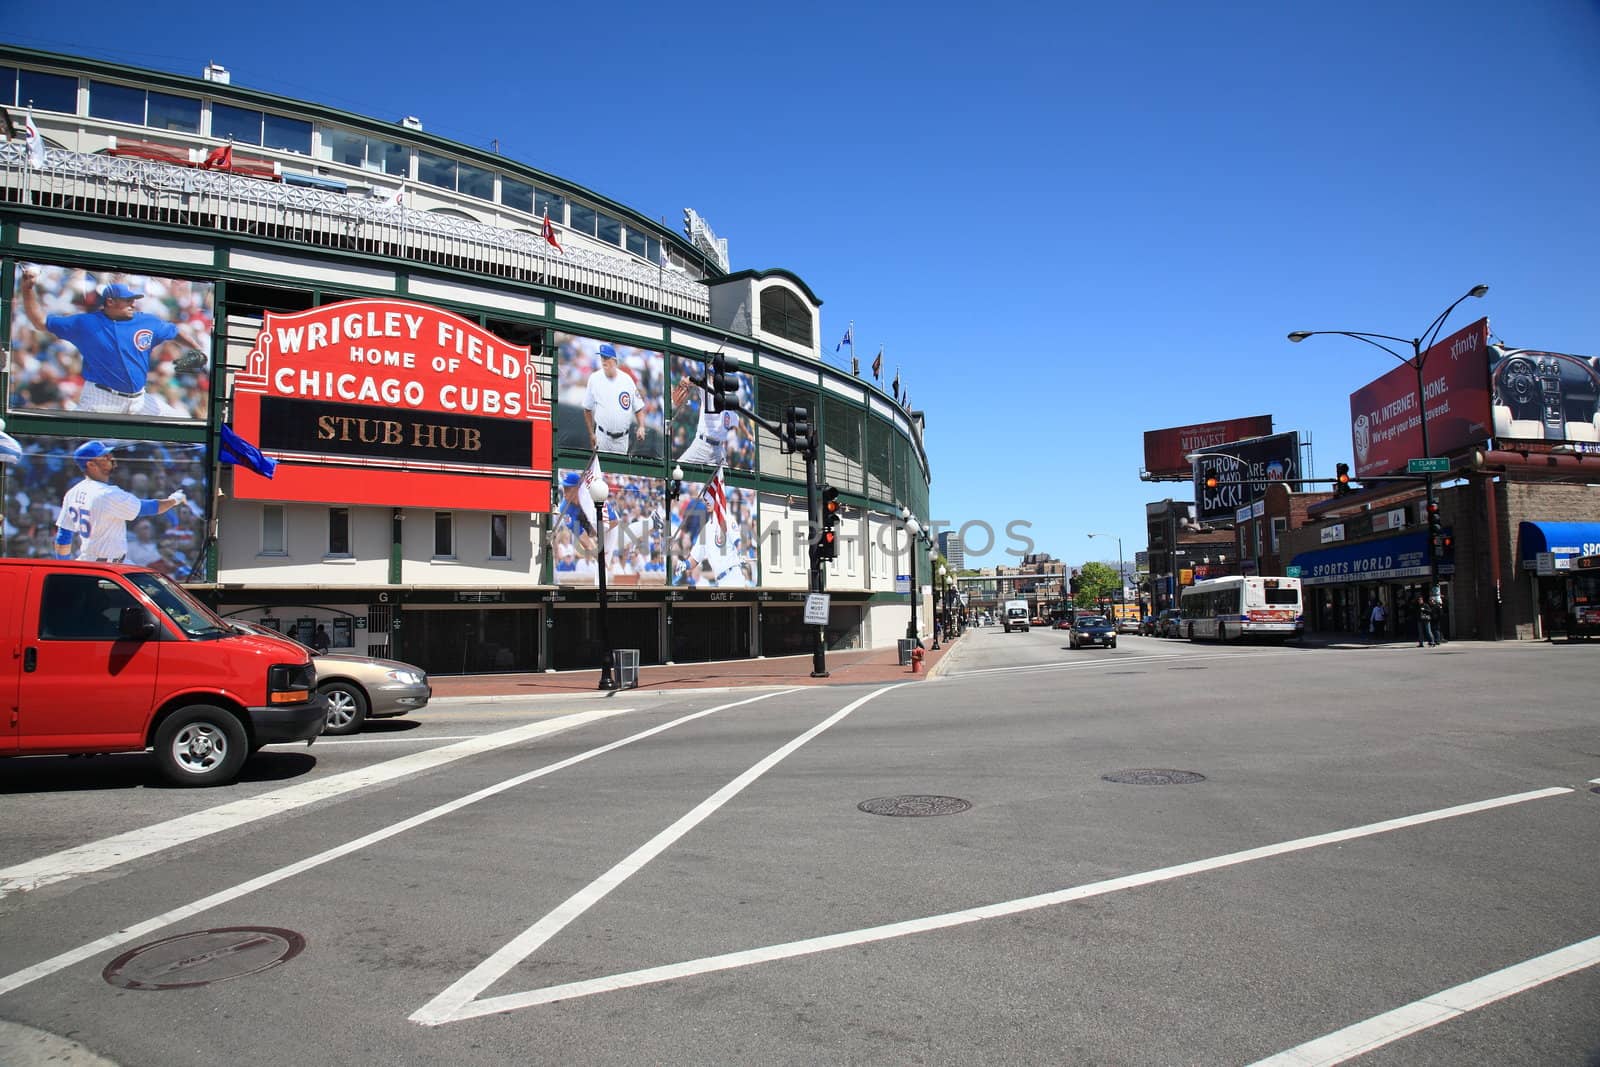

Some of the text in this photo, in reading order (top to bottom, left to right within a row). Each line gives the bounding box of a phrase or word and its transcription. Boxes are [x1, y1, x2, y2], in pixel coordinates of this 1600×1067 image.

[276, 311, 521, 379] WRIGLEY FIELD
[1450, 333, 1479, 360] xfinity
[350, 346, 462, 374] HOME OF
[274, 367, 522, 416] CHICAGO CUBS
[1382, 392, 1418, 422] INTERNET,
[1423, 377, 1449, 402] HONE.
[317, 414, 482, 451] STUB HUB
[1387, 425, 1397, 441] got
[1396, 420, 1409, 438] your
[1408, 414, 1423, 429] base
[1182, 433, 1226, 450] MIDWEST
[75, 491, 87, 505] LEE
[1313, 561, 1349, 577] SPORTS
[1353, 555, 1392, 572] WORLD
[379, 592, 389, 603] G
[710, 592, 735, 601] GATE F
